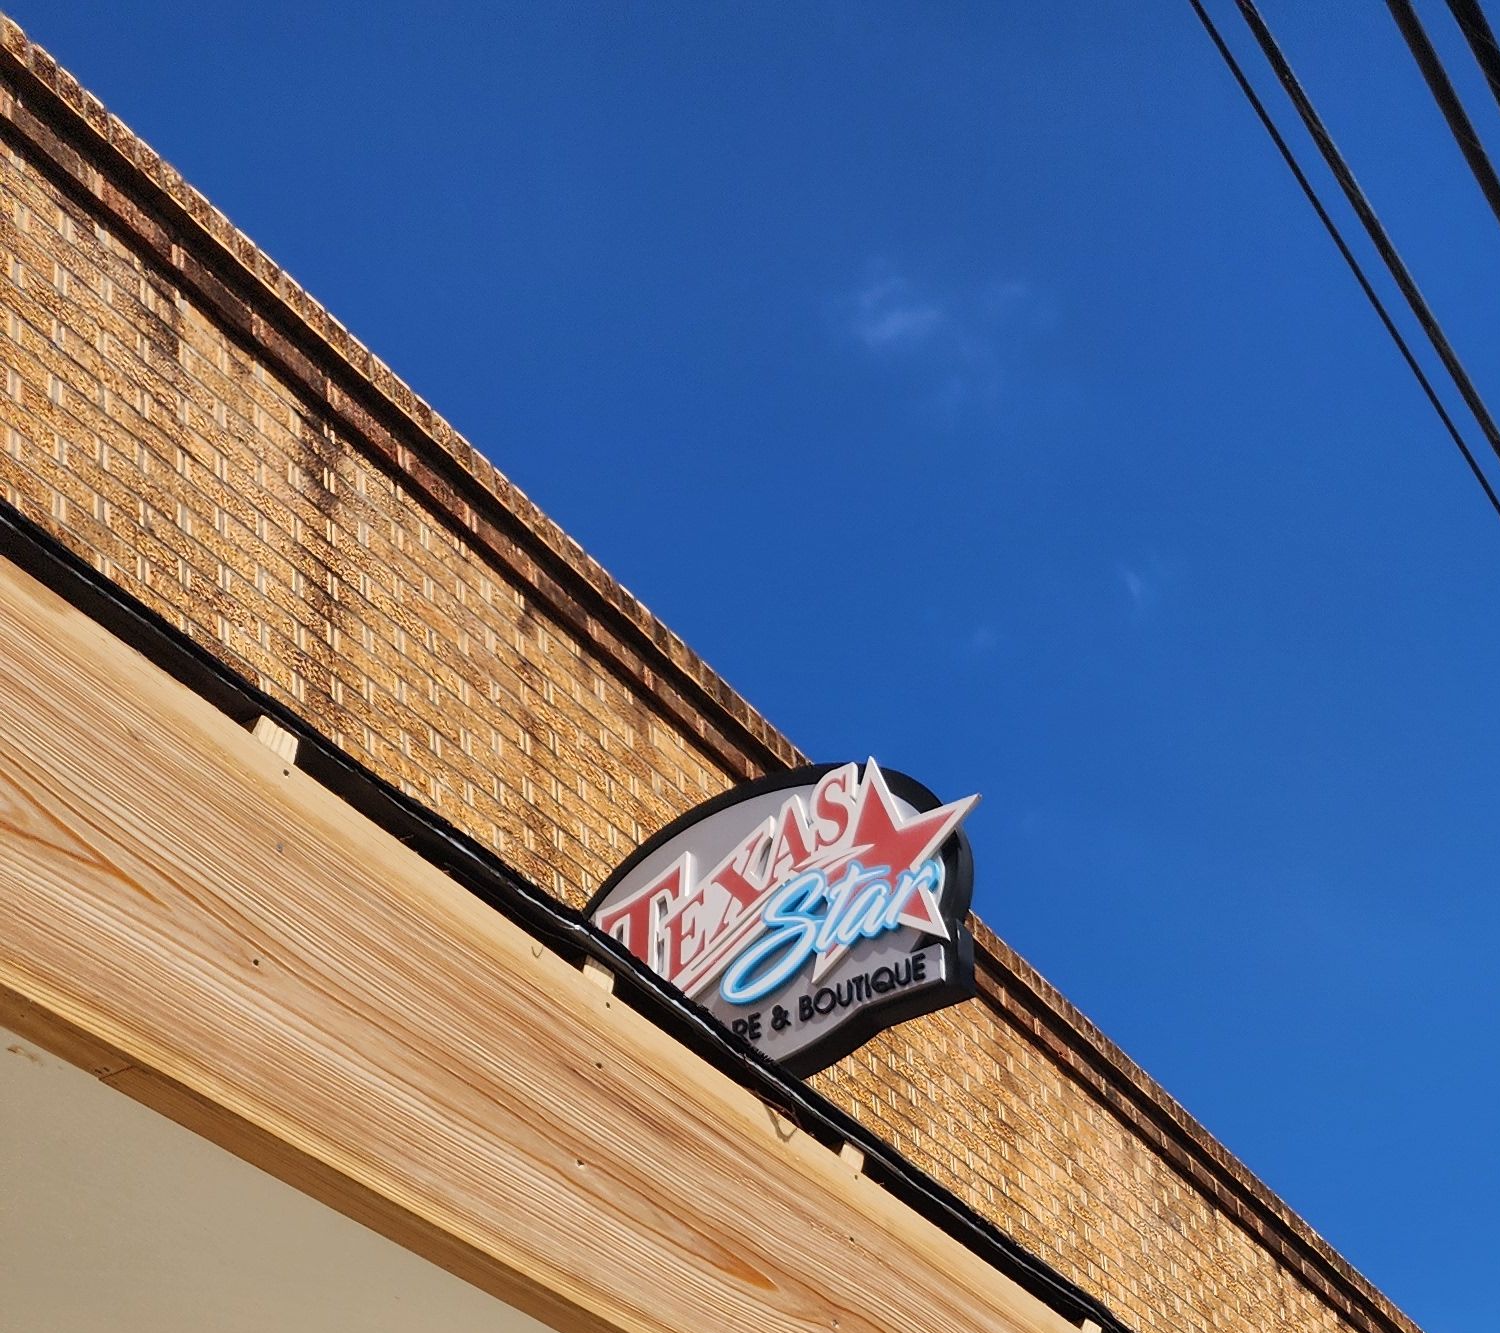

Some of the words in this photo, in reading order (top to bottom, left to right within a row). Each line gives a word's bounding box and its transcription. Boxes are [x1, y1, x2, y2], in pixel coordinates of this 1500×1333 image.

[597, 768, 854, 980] TEXAS
[720, 859, 942, 1005] Star
[771, 1004, 792, 1031] &
[798, 952, 927, 1023] BOUTIQUE
